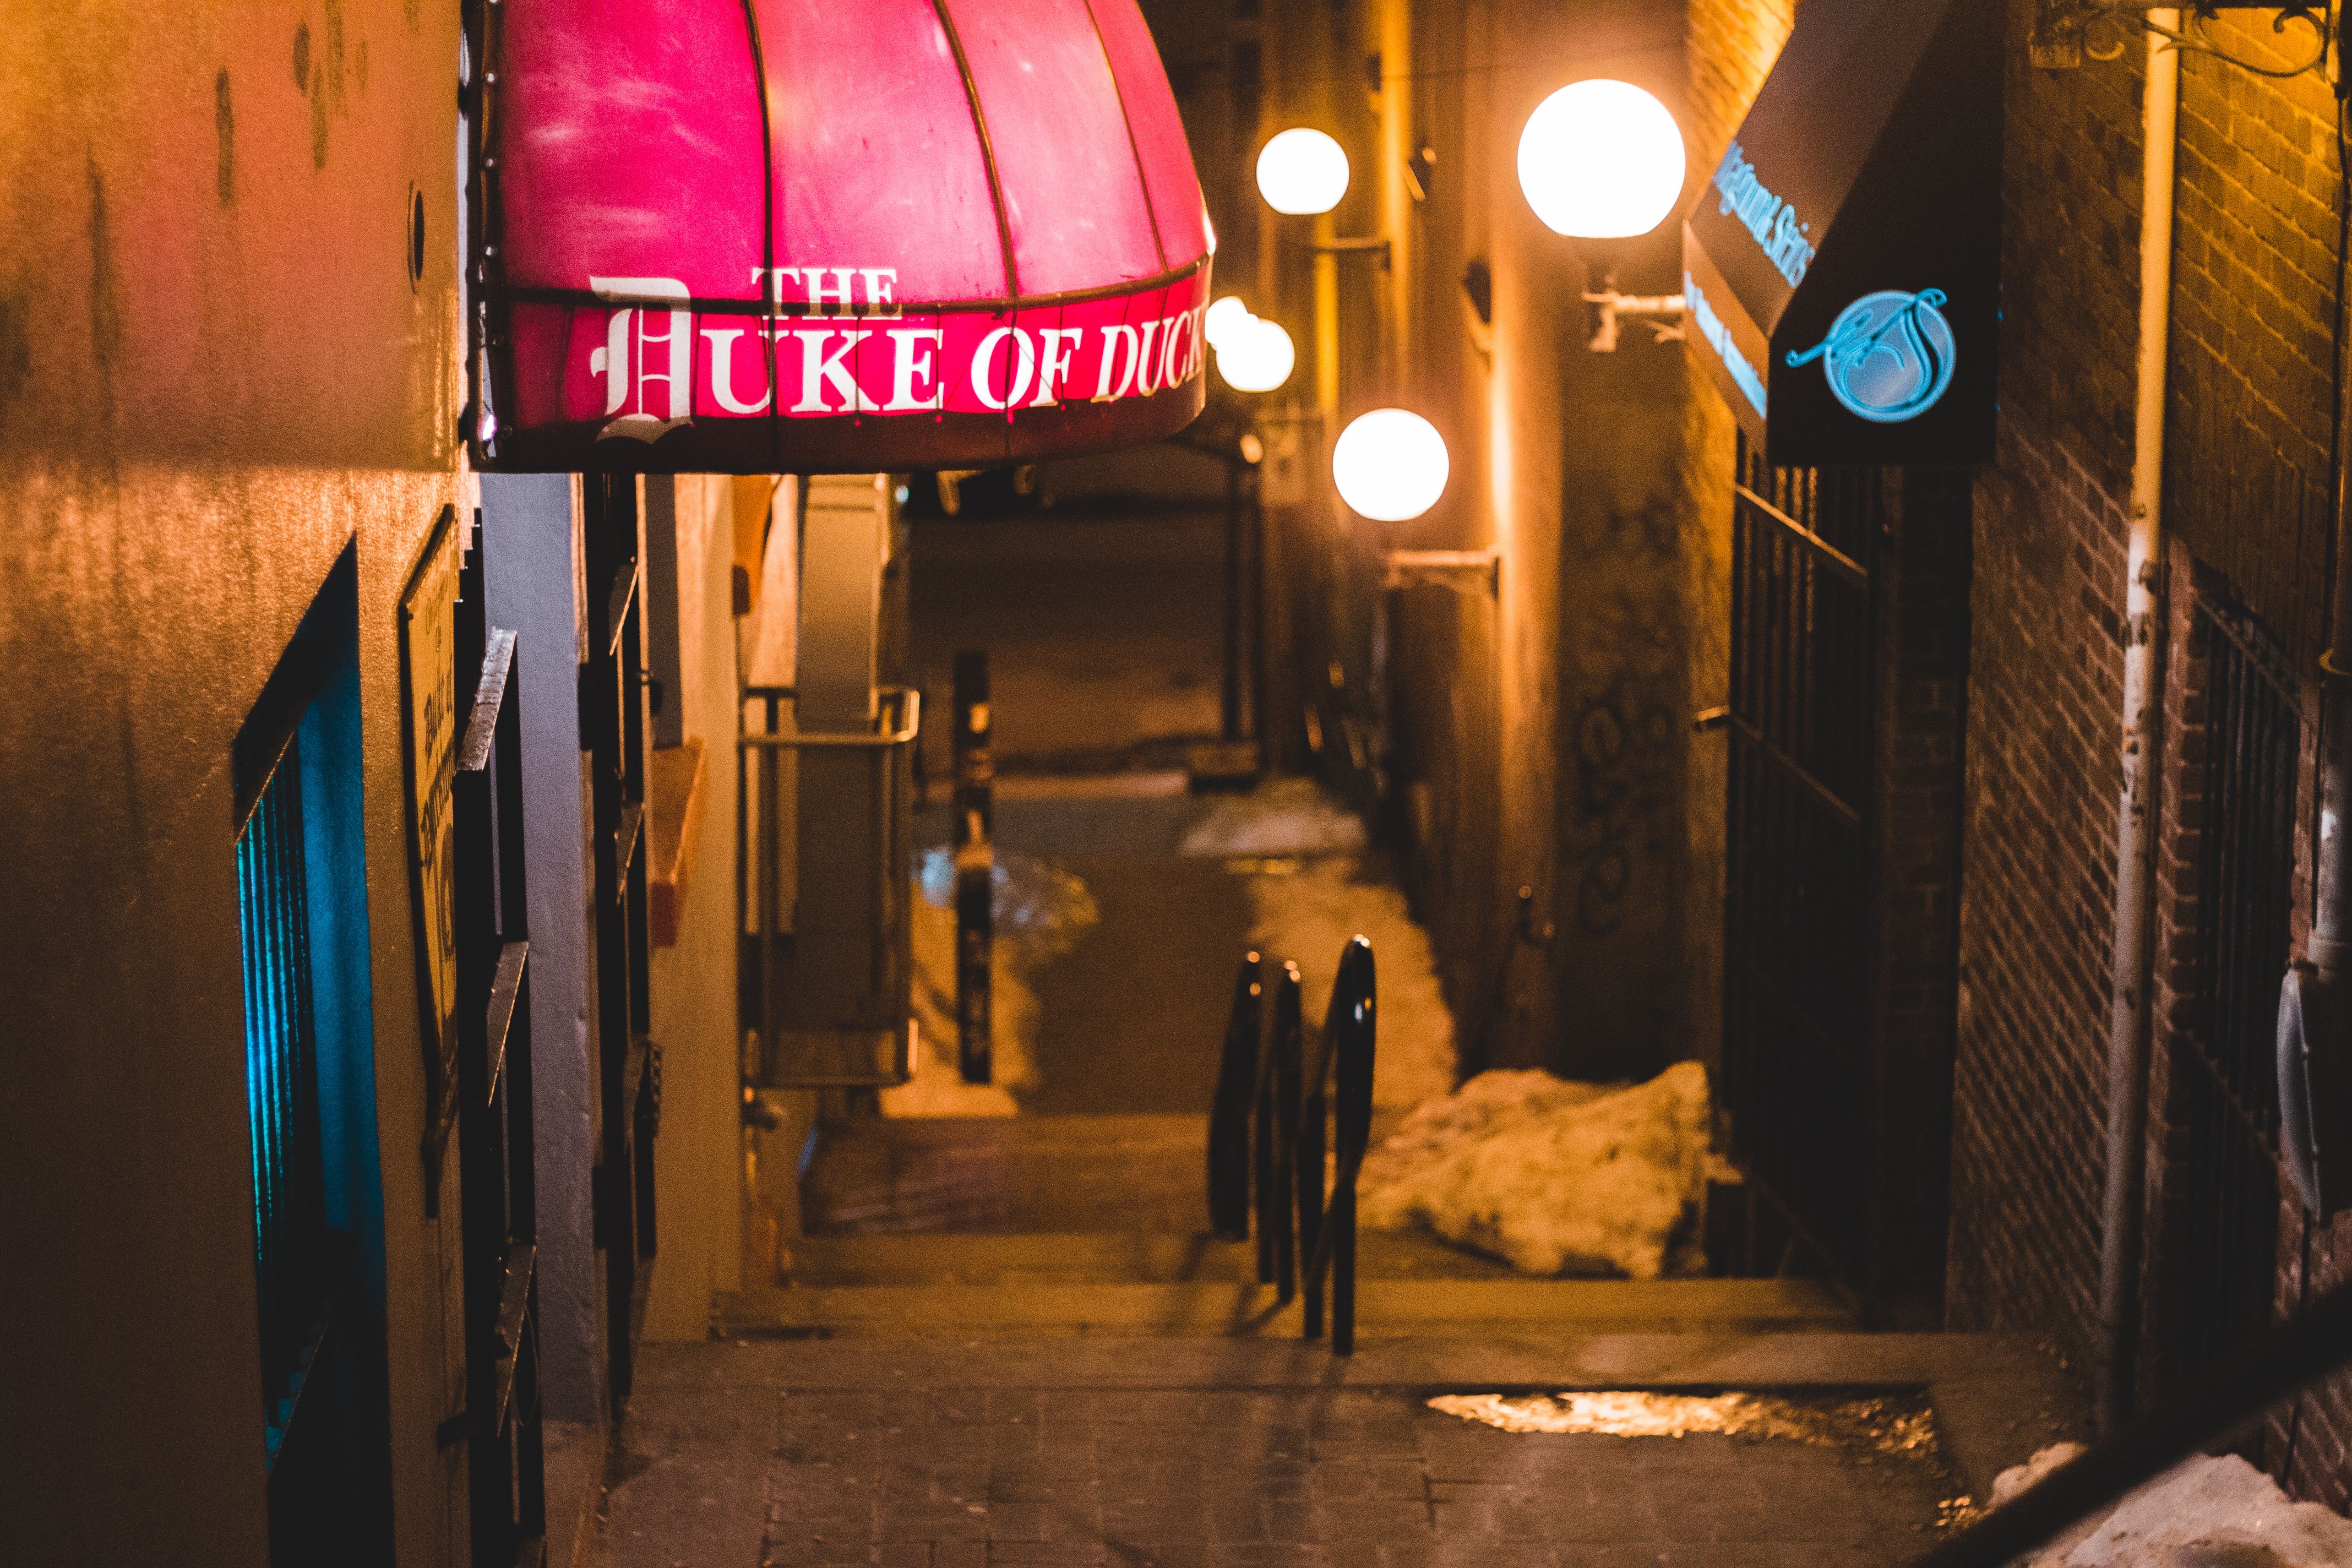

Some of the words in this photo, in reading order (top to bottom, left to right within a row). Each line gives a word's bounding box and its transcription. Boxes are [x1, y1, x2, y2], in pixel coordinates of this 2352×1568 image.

[752, 268, 902, 320] THE
[589, 275, 944, 444] DUKE
[971, 326, 1083, 407] OF
